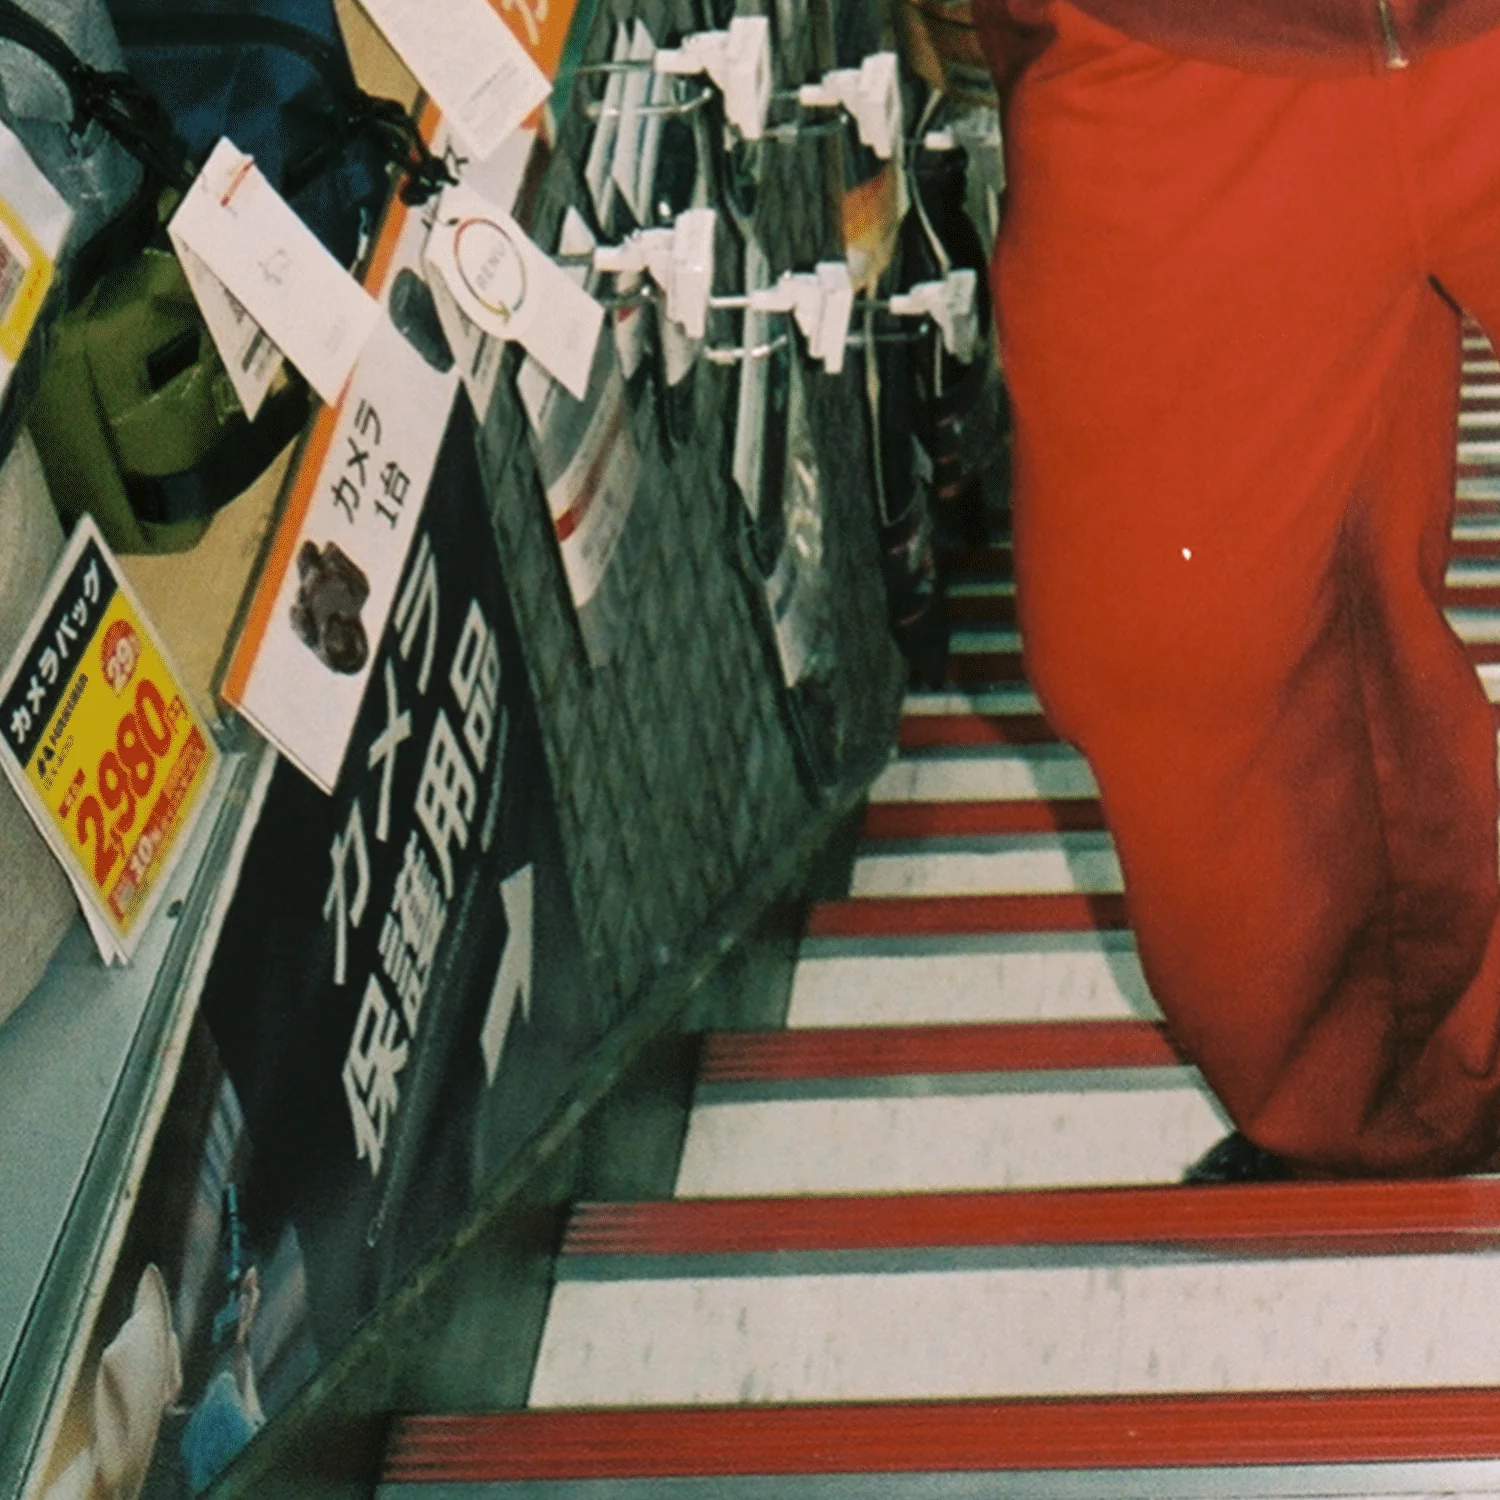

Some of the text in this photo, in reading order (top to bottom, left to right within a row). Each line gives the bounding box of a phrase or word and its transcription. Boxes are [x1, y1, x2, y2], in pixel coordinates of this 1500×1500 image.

[330, 398, 384, 526] カメラ
[373, 460, 414, 530] 1台
[10, 557, 101, 744] カメラバッグ
[323, 530, 440, 986] カメラ
[342, 597, 501, 1175] 保護用品
